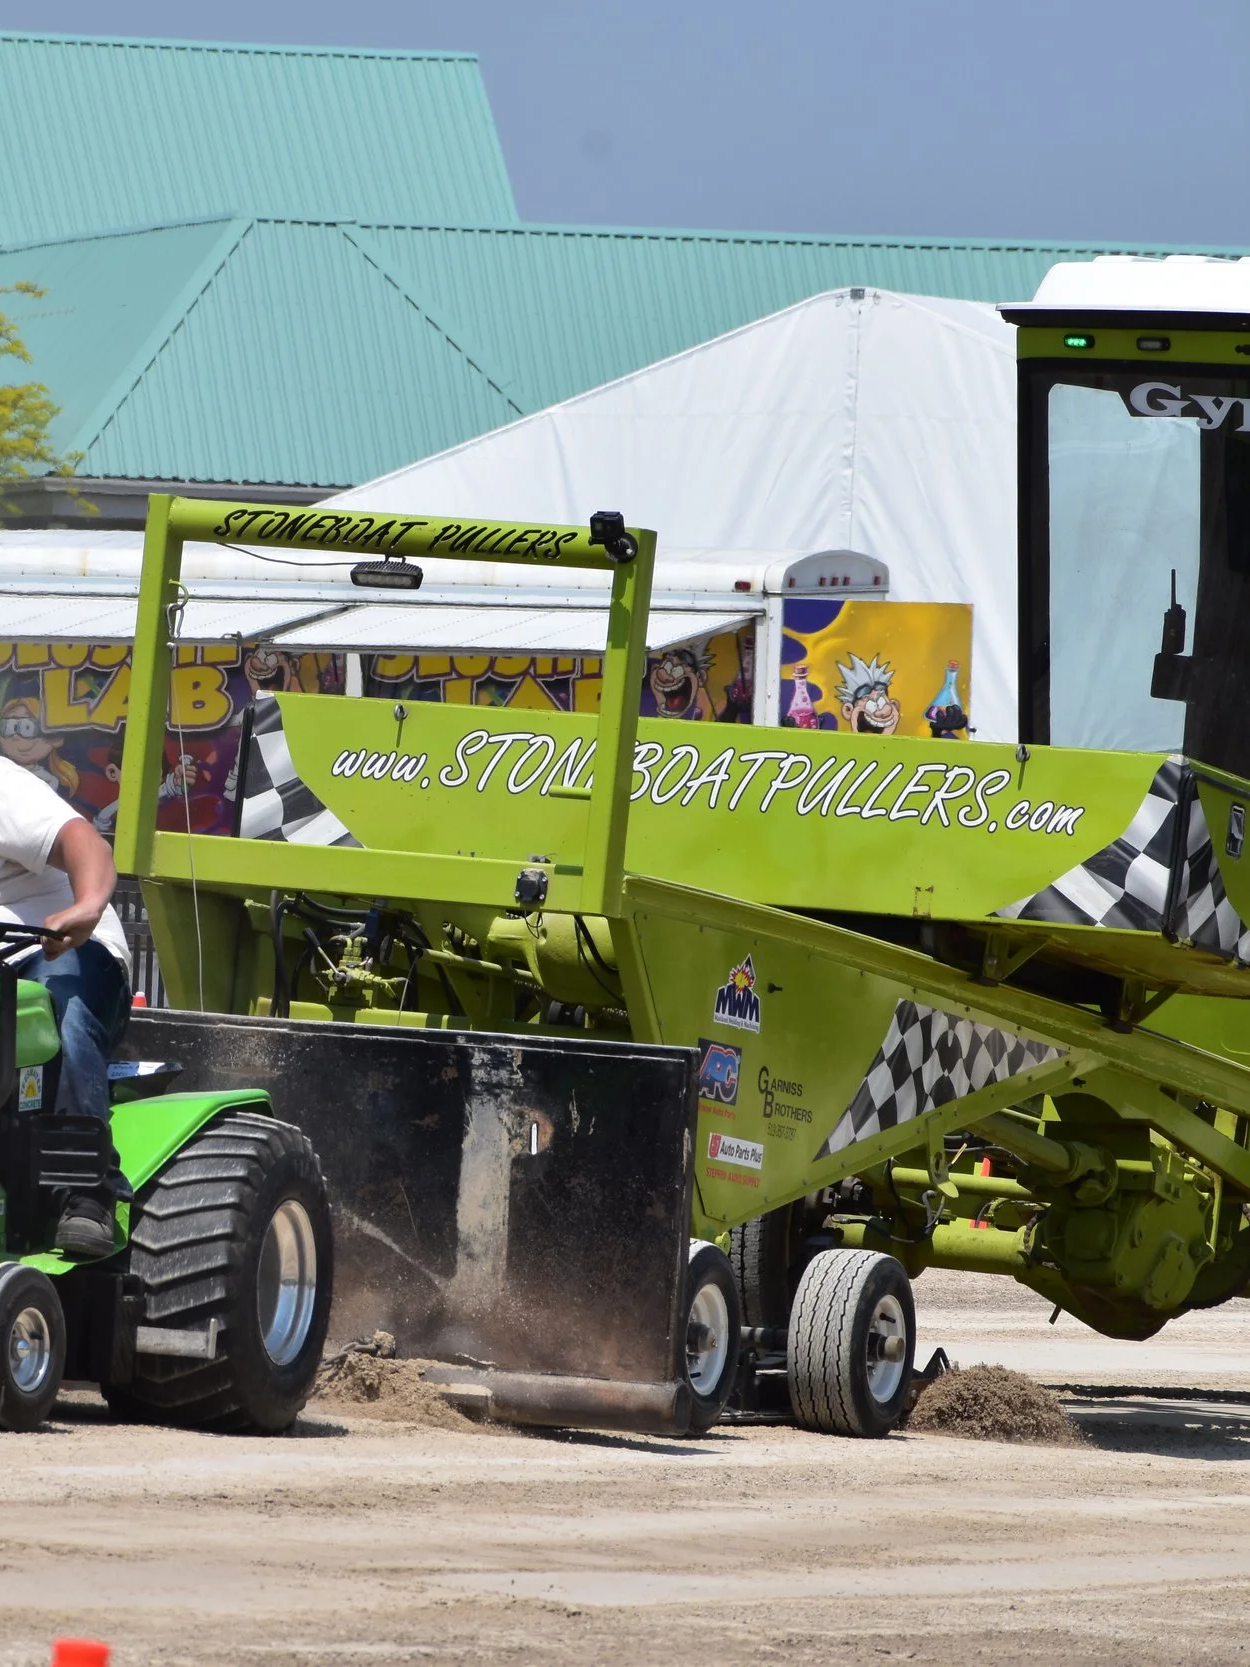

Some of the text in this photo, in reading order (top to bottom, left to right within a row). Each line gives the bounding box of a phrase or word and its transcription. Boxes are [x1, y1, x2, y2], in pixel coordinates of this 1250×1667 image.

[214, 508, 578, 560] STONEBOAT PULLERS
[331, 729, 1086, 836] www.STONBOATPULLERS.com
[758, 1065, 803, 1097] GARNISS
[763, 1091, 813, 1123] BROTHERS
[720, 1141, 763, 1164] Auto Parts Plus
